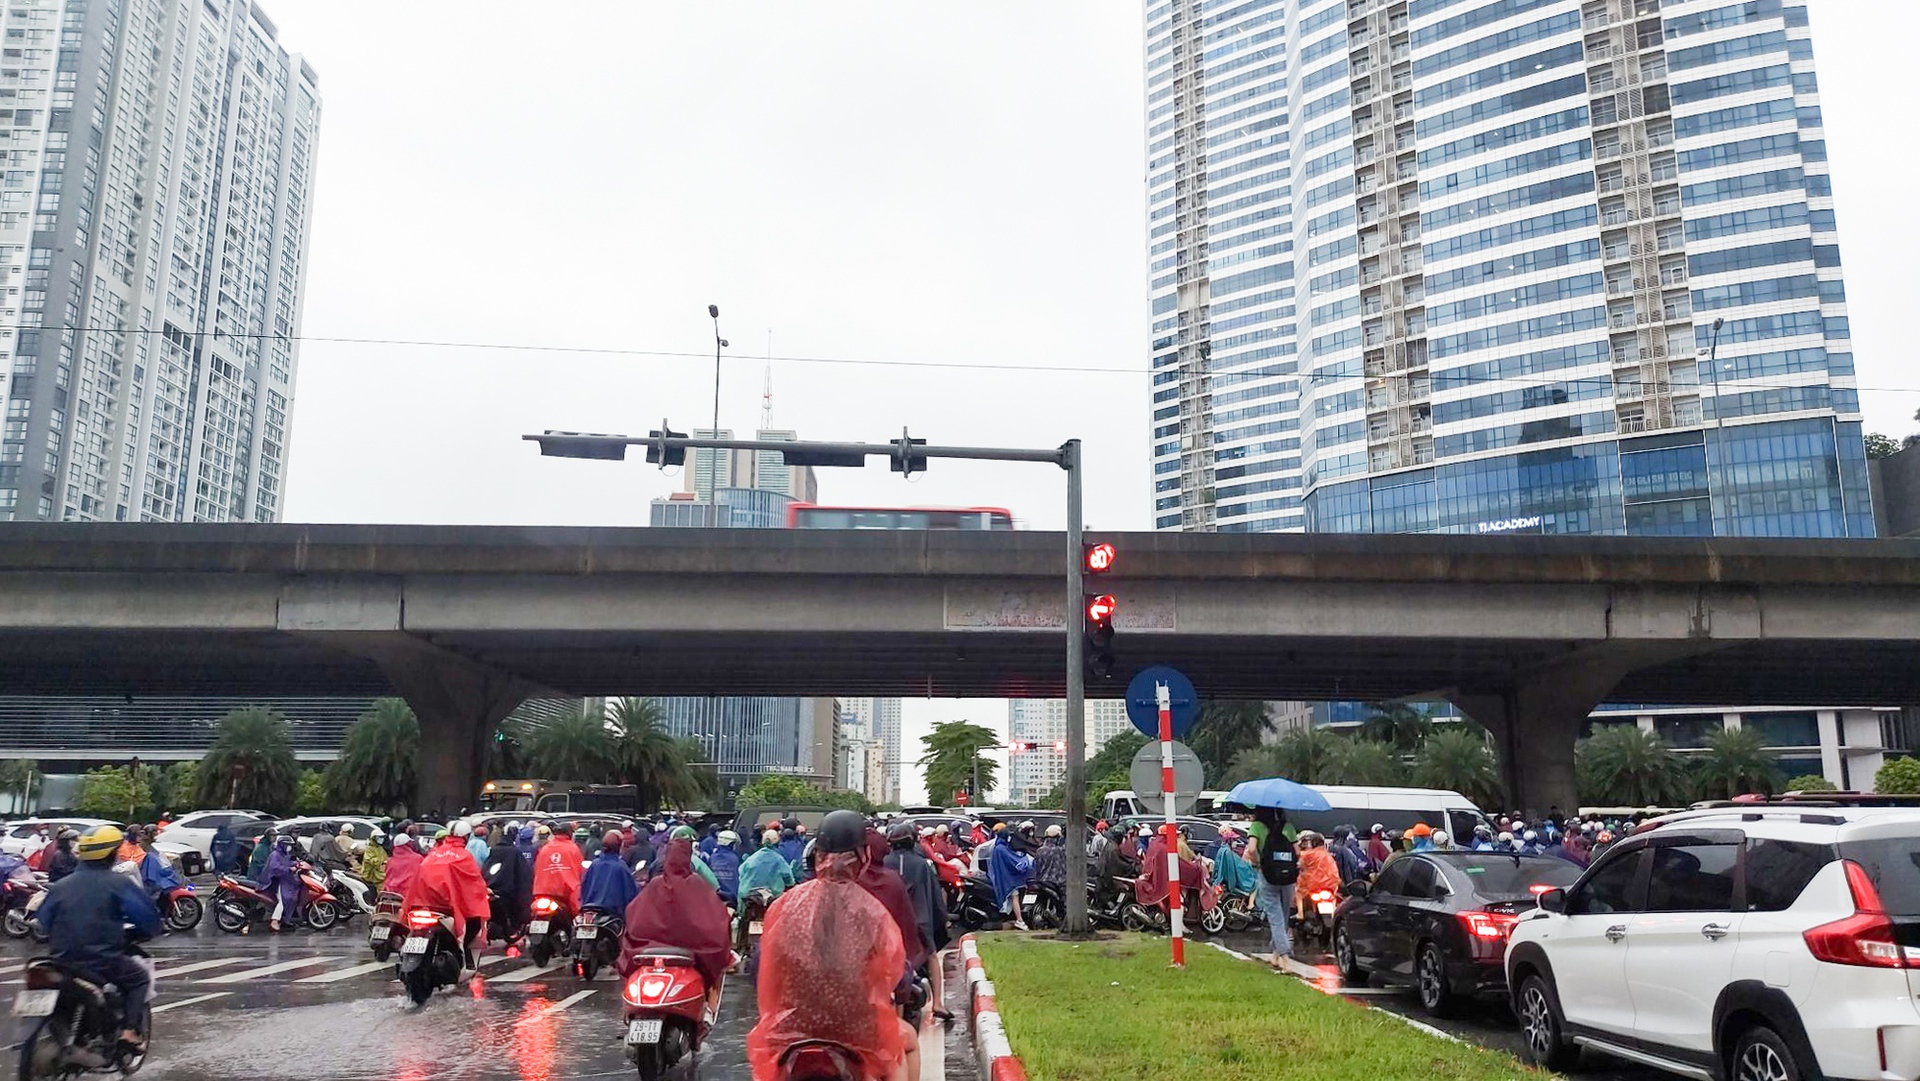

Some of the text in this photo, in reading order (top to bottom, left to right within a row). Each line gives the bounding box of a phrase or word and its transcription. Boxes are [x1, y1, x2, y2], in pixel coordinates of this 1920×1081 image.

[1487, 516, 1540, 532] ACADEMY
[634, 1021, 657, 1032] 29-T1
[630, 1032, 658, 1042] 418.95
